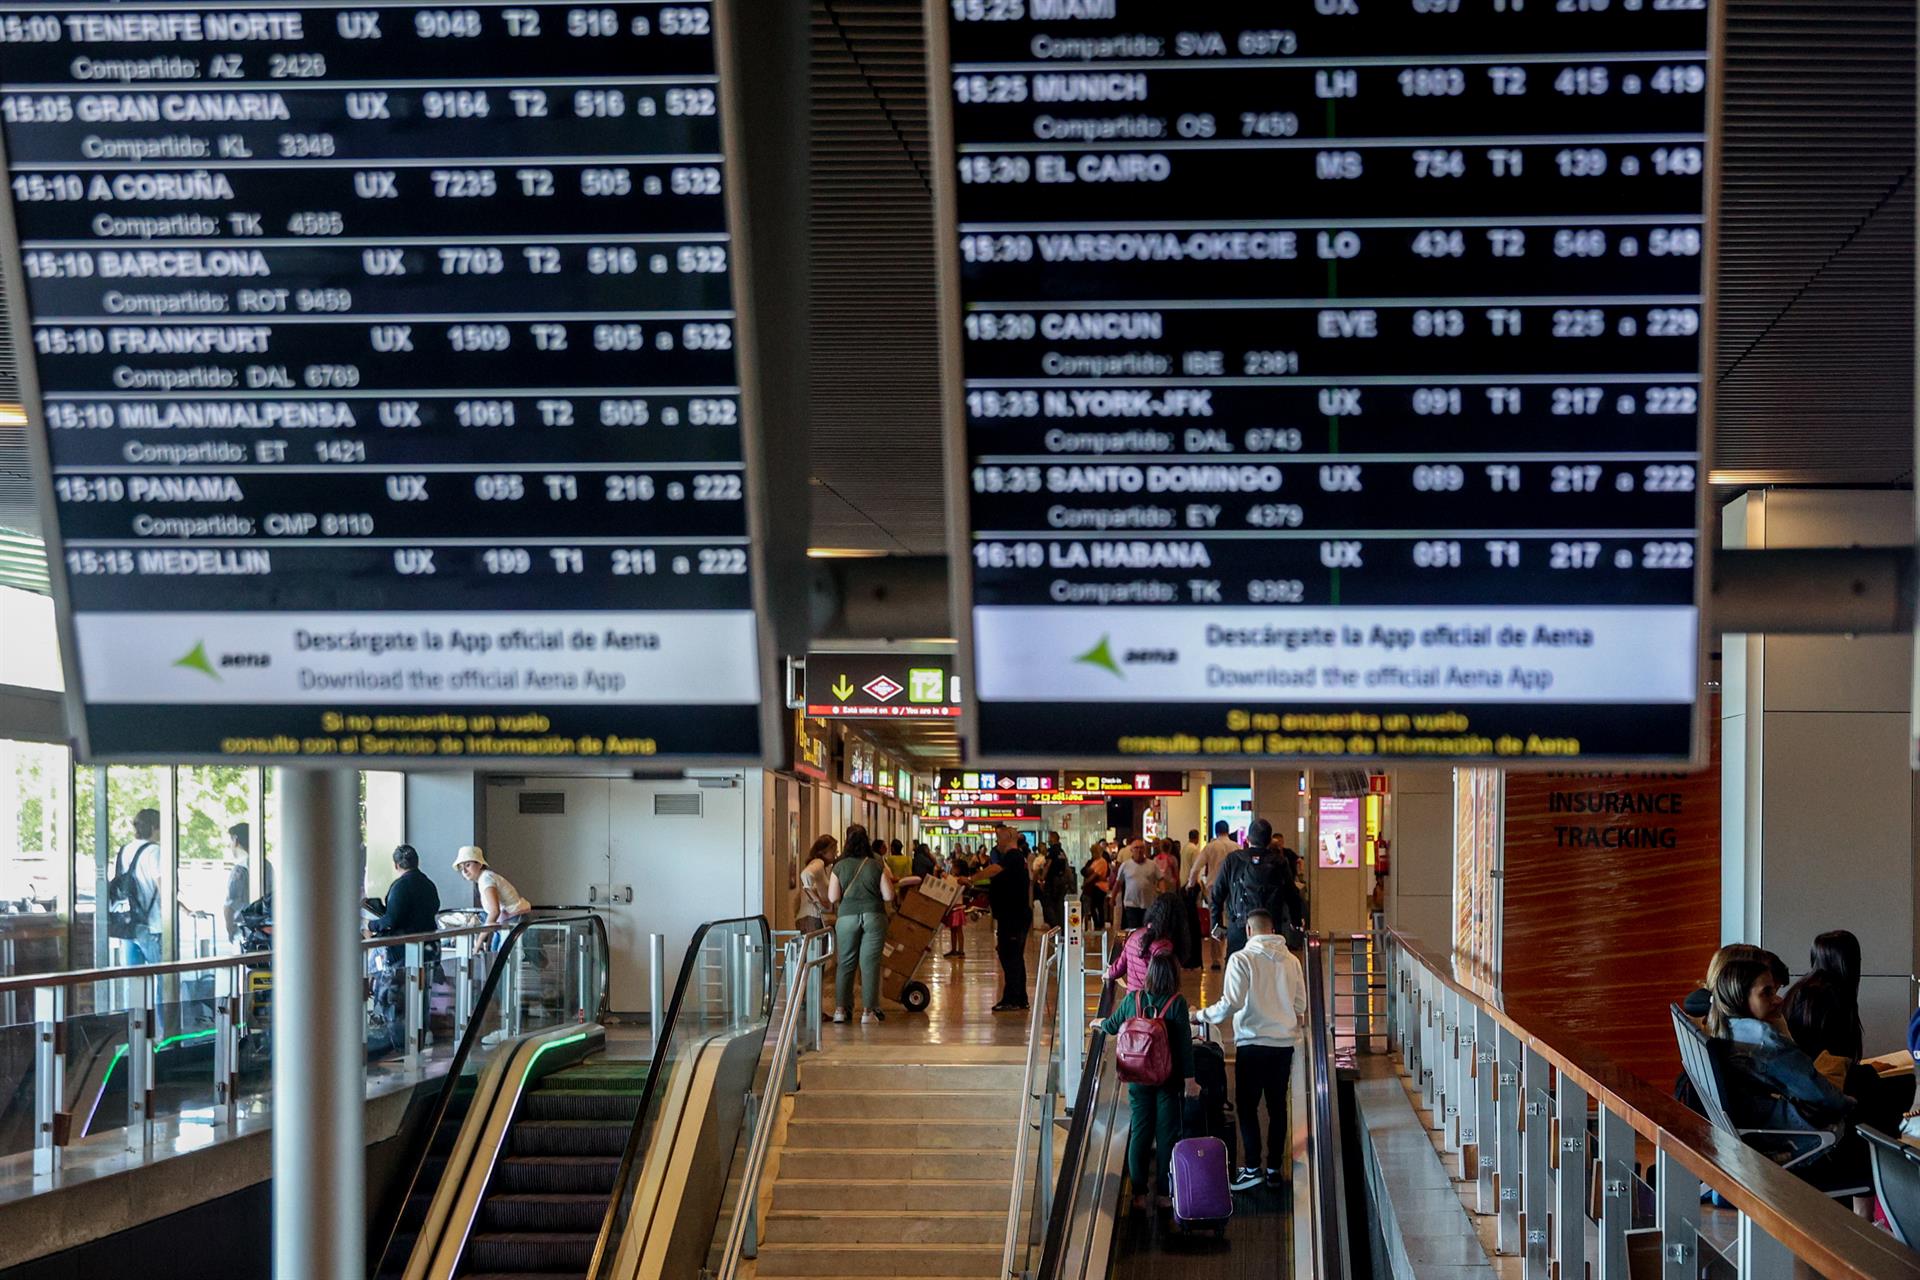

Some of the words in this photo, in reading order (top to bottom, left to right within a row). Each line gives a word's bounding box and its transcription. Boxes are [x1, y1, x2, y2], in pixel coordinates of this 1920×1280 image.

[65, 14, 203, 41] TENERIFE
[203, 12, 304, 41] NORTE
[337, 12, 381, 39] UX
[502, 9, 541, 36] T2
[659, 7, 710, 34] 532
[71, 56, 201, 82] Compartido:
[209, 54, 244, 79] AZ
[954, 75, 1028, 103] 15:25
[1032, 73, 1147, 101] MUNICH
[1315, 70, 1357, 98] LH
[1487, 67, 1527, 95] T2
[3, 95, 73, 121] 15:05
[77, 95, 160, 121] GRAN
[162, 93, 290, 120] CANARIA
[346, 93, 390, 119] UX
[423, 91, 489, 117] 9164
[509, 90, 548, 116] T2
[665, 89, 716, 116] 532
[82, 135, 211, 161] Compartido:
[218, 135, 252, 158] KL
[1035, 156, 1076, 183] EL
[1076, 154, 1171, 182] CAIRO
[1316, 151, 1363, 179] MS
[1487, 149, 1523, 177] T1
[12, 175, 84, 200] 15:10
[88, 175, 113, 200] A
[112, 170, 234, 199] CORUÑA
[354, 172, 398, 198] UX
[431, 170, 497, 197] 7235
[516, 169, 555, 196] T2
[671, 168, 722, 194] 532
[92, 213, 221, 240] Compartido:
[227, 213, 263, 236] TK
[1037, 231, 1298, 261] VARSOVIA-OKECIE
[1316, 230, 1361, 259] LO
[1487, 229, 1526, 257] T2
[24, 252, 94, 278] 15:10
[98, 250, 270, 277] BARCELONA
[362, 249, 406, 275] UX
[438, 248, 503, 275] 7703
[523, 247, 561, 274] T2
[676, 246, 727, 273] 532
[103, 290, 230, 316] Compartido:
[237, 290, 289, 312] ROT
[1041, 312, 1162, 340] CANCUN
[1318, 310, 1378, 337] EVE
[1486, 308, 1522, 336] T1
[34, 328, 104, 353] 15:10
[107, 326, 272, 353] FRANKFURT
[370, 325, 414, 352] UX
[530, 324, 568, 350] T2
[682, 324, 732, 350] 532
[113, 366, 239, 392] Compartido:
[246, 366, 296, 388] DAL
[46, 405, 114, 429] 15:10
[378, 401, 421, 427] UX
[536, 400, 574, 426] T2
[688, 400, 737, 426] 532
[1043, 389, 1213, 417] N.YORK-JFK
[1318, 388, 1362, 416] UX
[1486, 387, 1521, 415] T1
[1645, 387, 1698, 414] 222
[1184, 428, 1234, 451] DAL
[122, 441, 248, 466] Compartido:
[255, 441, 288, 463] ET
[56, 479, 125, 502] 15:10
[128, 477, 244, 502] PANAMA
[386, 476, 429, 501] UX
[543, 475, 578, 500] T1
[693, 475, 742, 500] 222
[1046, 465, 1144, 493] SANTO
[1146, 464, 1283, 492] DOMINGO
[1319, 464, 1362, 492] UX
[1486, 464, 1521, 492] T1
[1644, 464, 1696, 492] 222
[133, 514, 256, 539] Compartido:
[263, 514, 317, 536] CMP
[1186, 504, 1221, 527] EY
[66, 551, 135, 575] 15:15
[138, 550, 272, 574] MEDELLIN
[394, 549, 436, 574] UX
[551, 549, 583, 574] T1
[611, 549, 656, 575] 211
[699, 549, 747, 575] 222
[973, 541, 1044, 568] 16:10
[1050, 541, 1089, 568] LA
[1091, 540, 1211, 568] HABANA
[1320, 541, 1363, 567] UX
[1486, 541, 1520, 568] T1
[1642, 542, 1694, 568] 222
[1187, 580, 1222, 602] TK
[295, 629, 417, 654] Descárgate
[423, 630, 443, 648] la
[450, 630, 492, 653] App
[500, 629, 564, 650] oficial
[568, 629, 597, 648] de
[603, 629, 661, 649] Aena
[1205, 624, 1335, 651] Descárgate
[1342, 626, 1363, 645] la
[1370, 626, 1414, 650] App
[1421, 624, 1490, 646] oficial
[1497, 624, 1525, 646] de
[1532, 626, 1593, 646] Aena
[220, 655, 271, 668] aena
[1123, 649, 1179, 663] aena
[301, 670, 403, 690] Download
[408, 669, 444, 690] the
[450, 669, 519, 690] official
[525, 671, 578, 690] Aena
[583, 672, 626, 692] App
[912, 671, 943, 700] T2
[1206, 665, 1316, 686] Download
[1322, 664, 1358, 686] the
[1364, 666, 1440, 686] official
[1446, 667, 1500, 686] Aena
[1507, 666, 1553, 688] App
[363, 736, 436, 754] Servicio
[1548, 792, 1682, 814] INSURANCE
[1554, 825, 1677, 848] TRACKING
